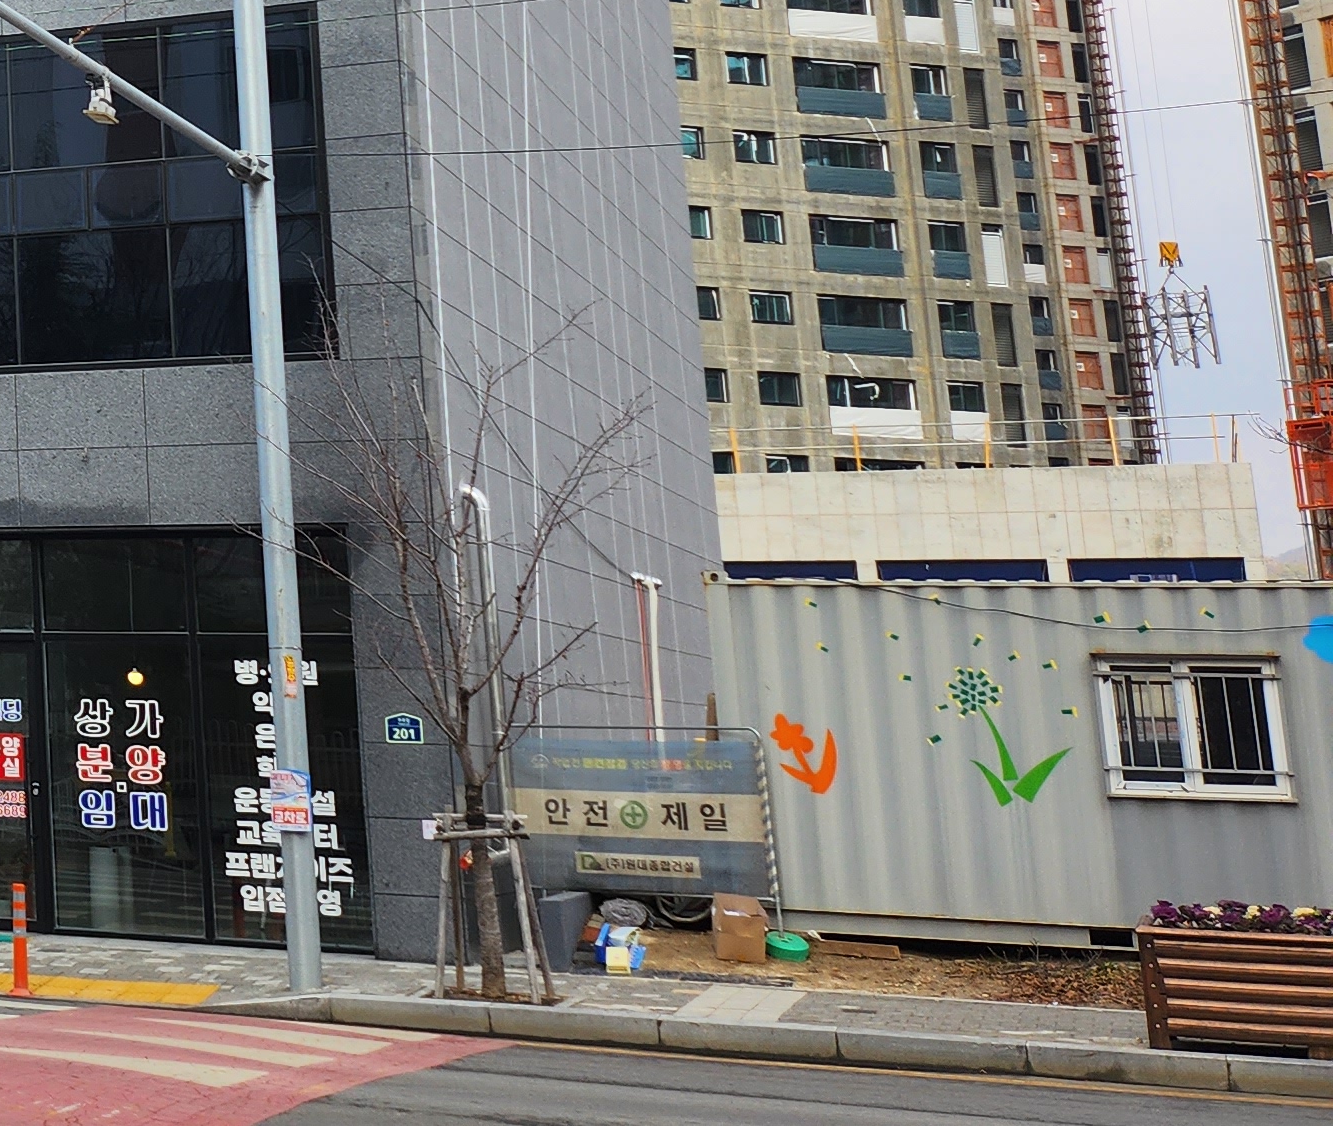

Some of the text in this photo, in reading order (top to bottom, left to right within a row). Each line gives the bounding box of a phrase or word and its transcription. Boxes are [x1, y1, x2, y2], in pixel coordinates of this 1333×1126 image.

[234, 659, 319, 686] 병·원
[73, 698, 164, 738] 상가
[392, 727, 416, 740] 201
[75, 743, 167, 784] 분양
[78, 790, 168, 831] 임대
[544, 797, 729, 833] 안전 제일
[236, 820, 339, 850] 교육터
[239, 884, 342, 917] 입점영
